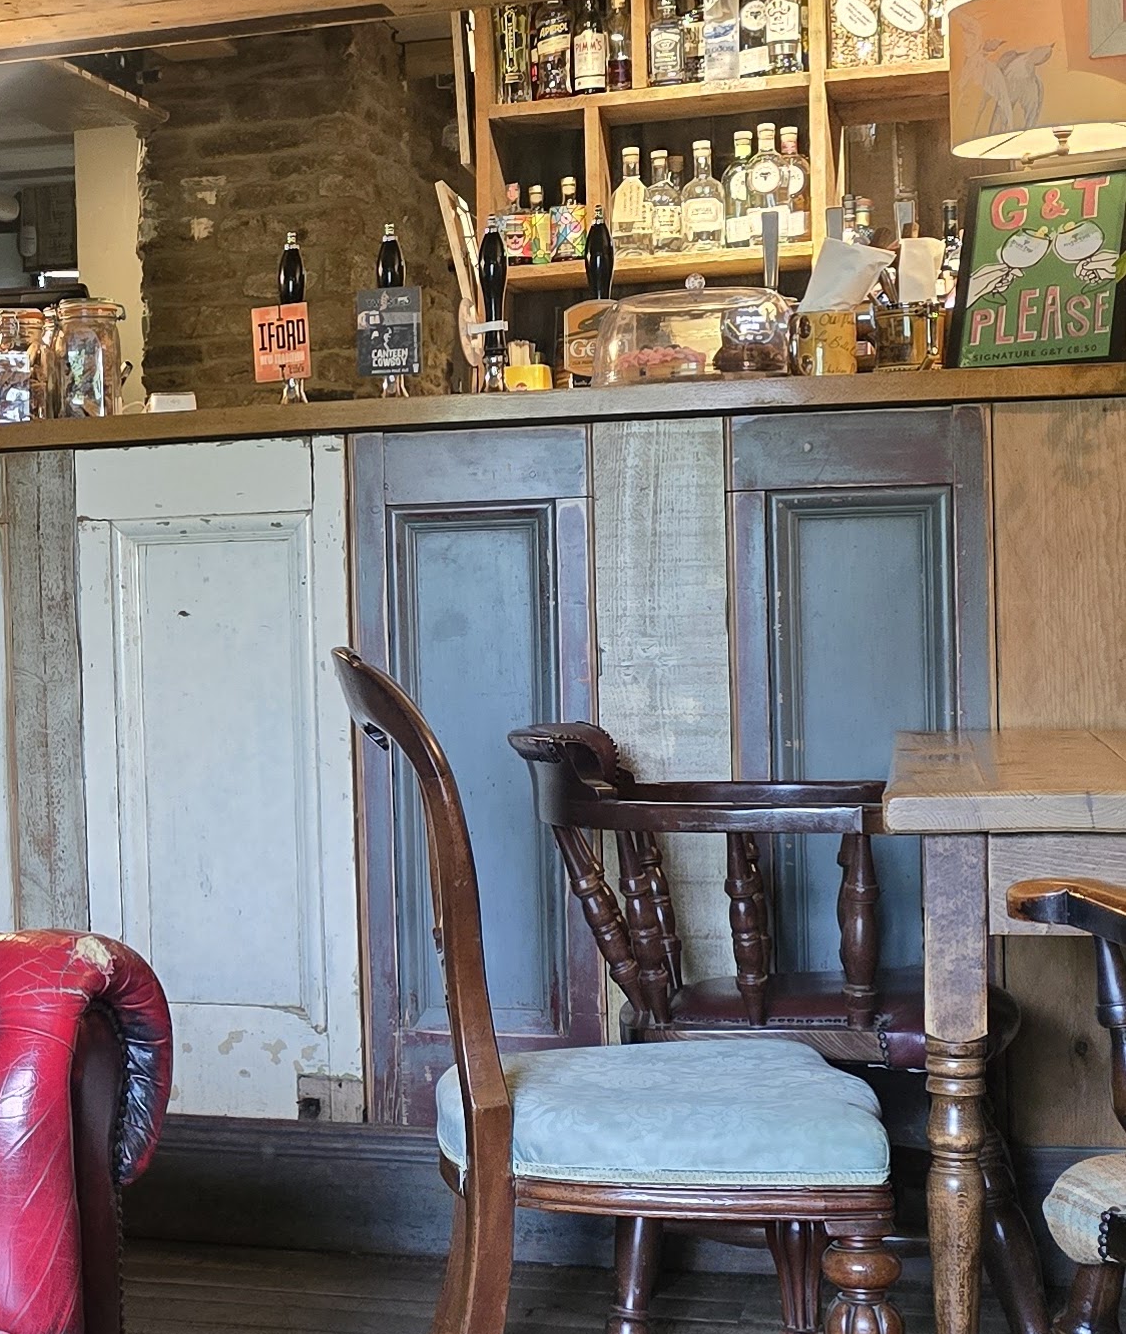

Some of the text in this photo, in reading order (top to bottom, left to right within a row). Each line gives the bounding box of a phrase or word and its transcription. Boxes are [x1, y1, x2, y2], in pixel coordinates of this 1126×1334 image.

[539, 23, 569, 39] APEROL
[575, 39, 603, 53] PIMM'S
[969, 285, 1111, 346] PLEASE
[258, 318, 306, 352] IFORD
[372, 348, 408, 358] CANTEEN
[972, 348, 1036, 362] SIGNATURE
[1040, 346, 1064, 356] G&T
[373, 357, 407, 367] COWBOY
